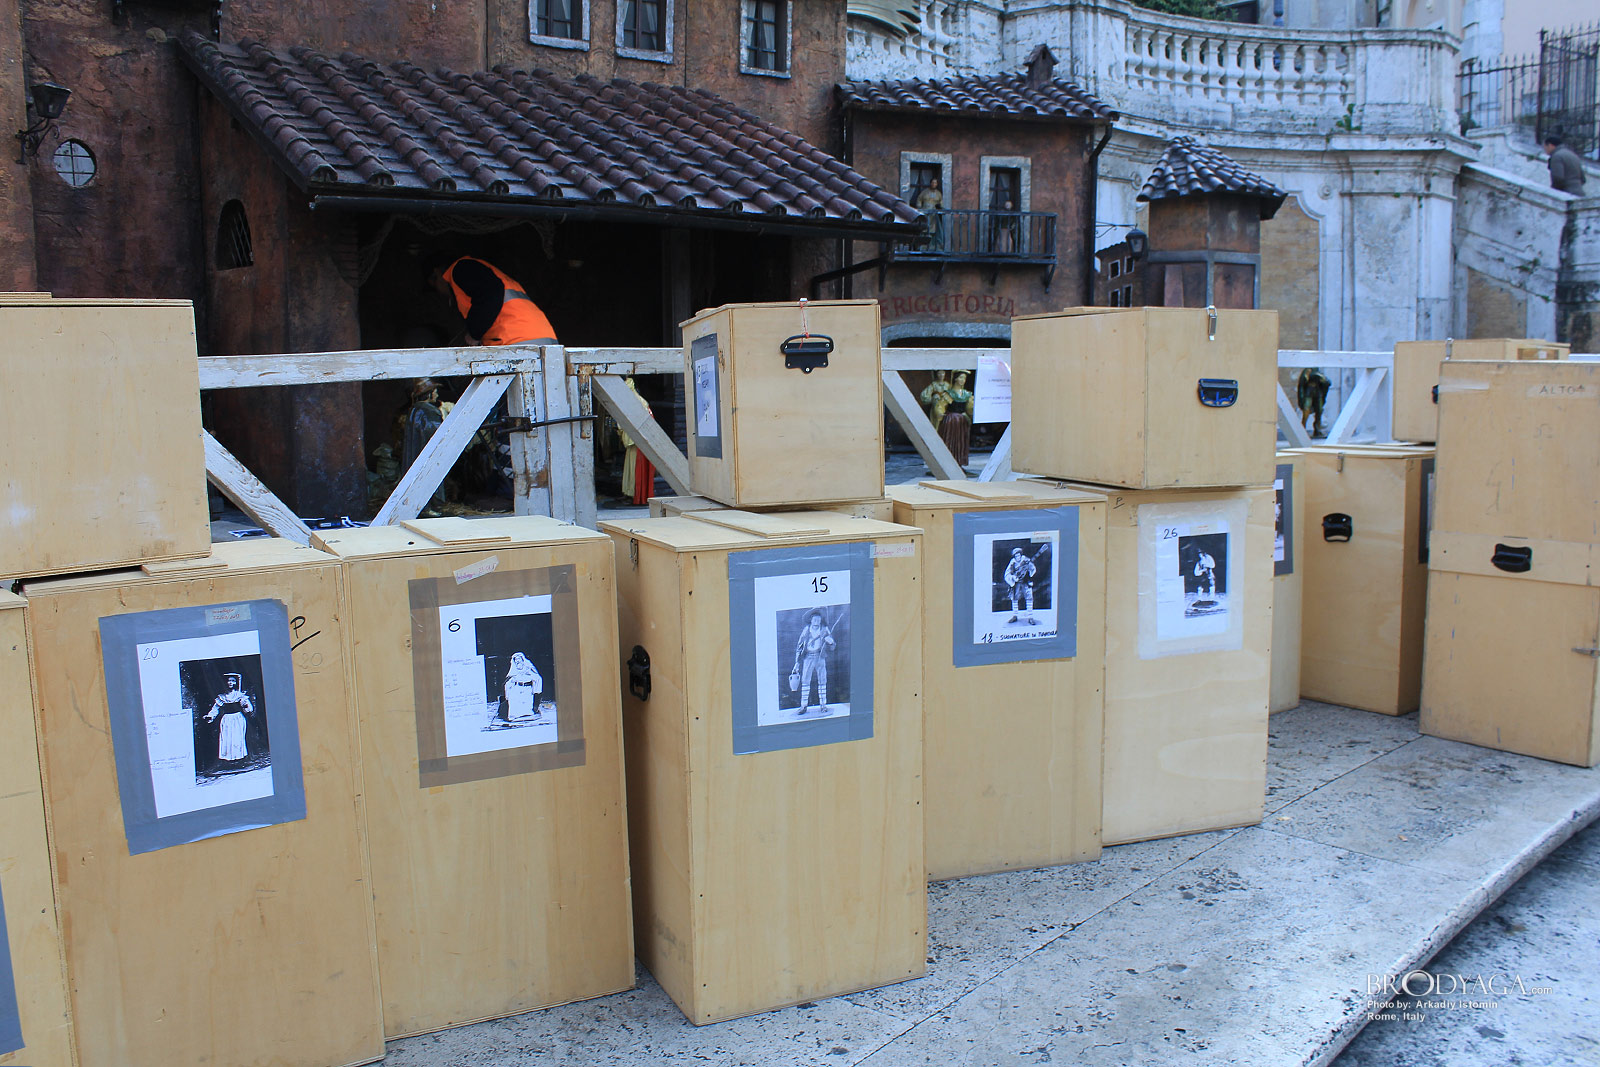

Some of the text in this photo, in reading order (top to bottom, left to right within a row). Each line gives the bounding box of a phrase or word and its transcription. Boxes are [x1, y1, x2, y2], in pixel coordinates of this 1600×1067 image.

[880, 294, 1018, 320] FRIGGITORIA
[1163, 527, 1178, 540] 26
[811, 576, 829, 593] 15
[448, 618, 461, 633] 6
[981, 632, 993, 644] 18
[143, 647, 159, 661] 20
